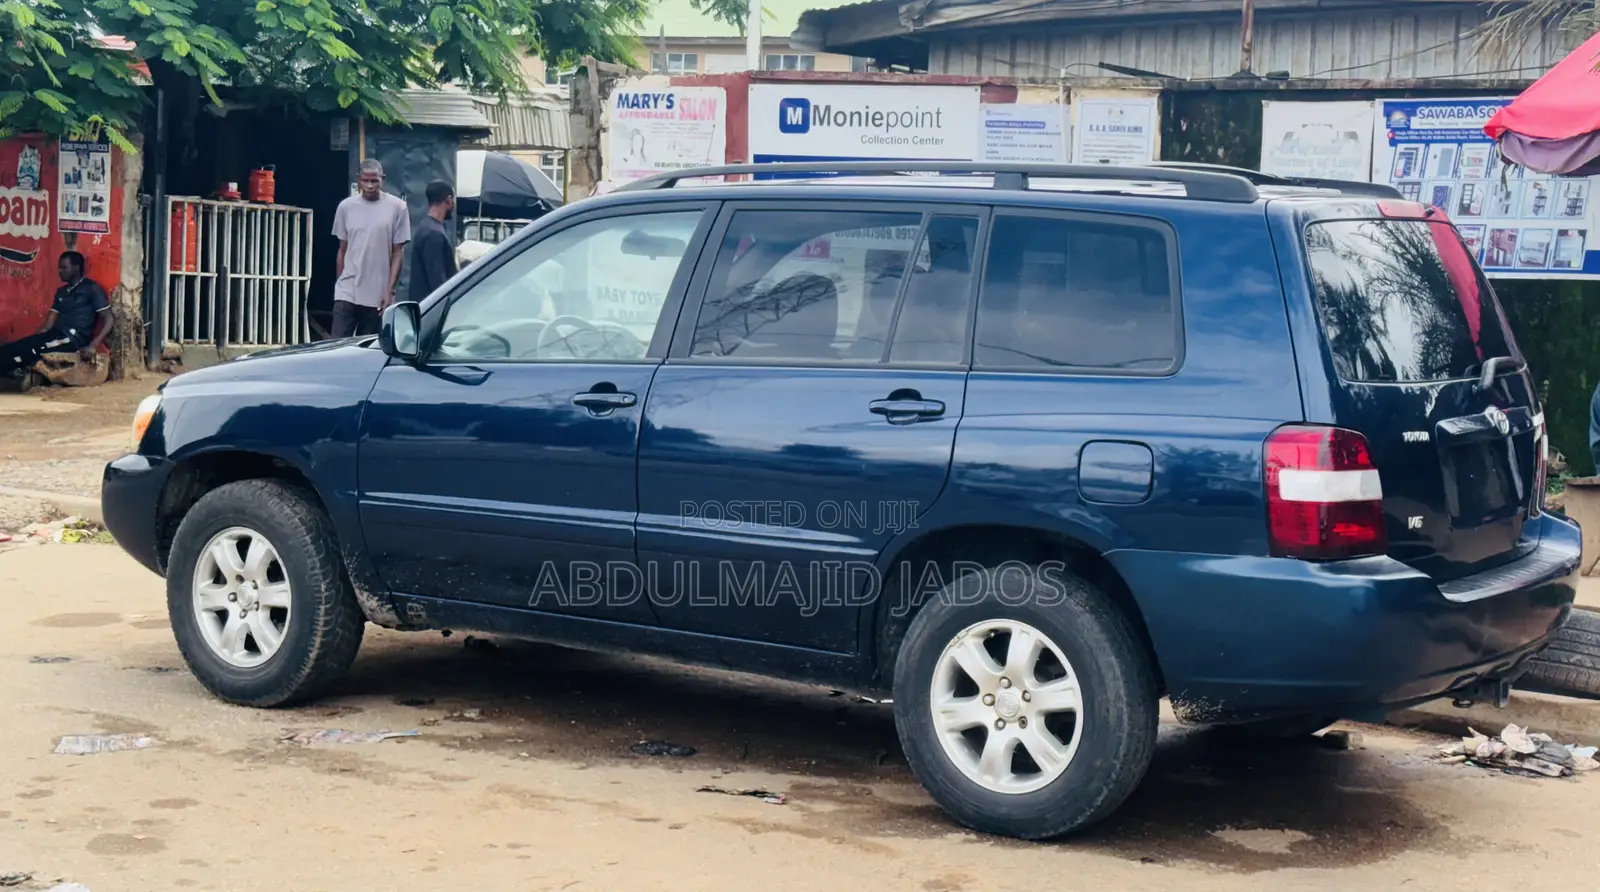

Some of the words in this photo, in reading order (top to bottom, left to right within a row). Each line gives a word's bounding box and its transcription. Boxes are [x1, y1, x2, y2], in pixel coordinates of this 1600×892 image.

[616, 93, 675, 109] MARY'S
[679, 97, 717, 120] SALON
[1418, 106, 1475, 119] SAWABA
[787, 107, 802, 125] M
[812, 104, 942, 132] Moniepoint
[861, 135, 909, 145] Collection
[912, 135, 945, 146] Center
[1408, 516, 1424, 529] V6
